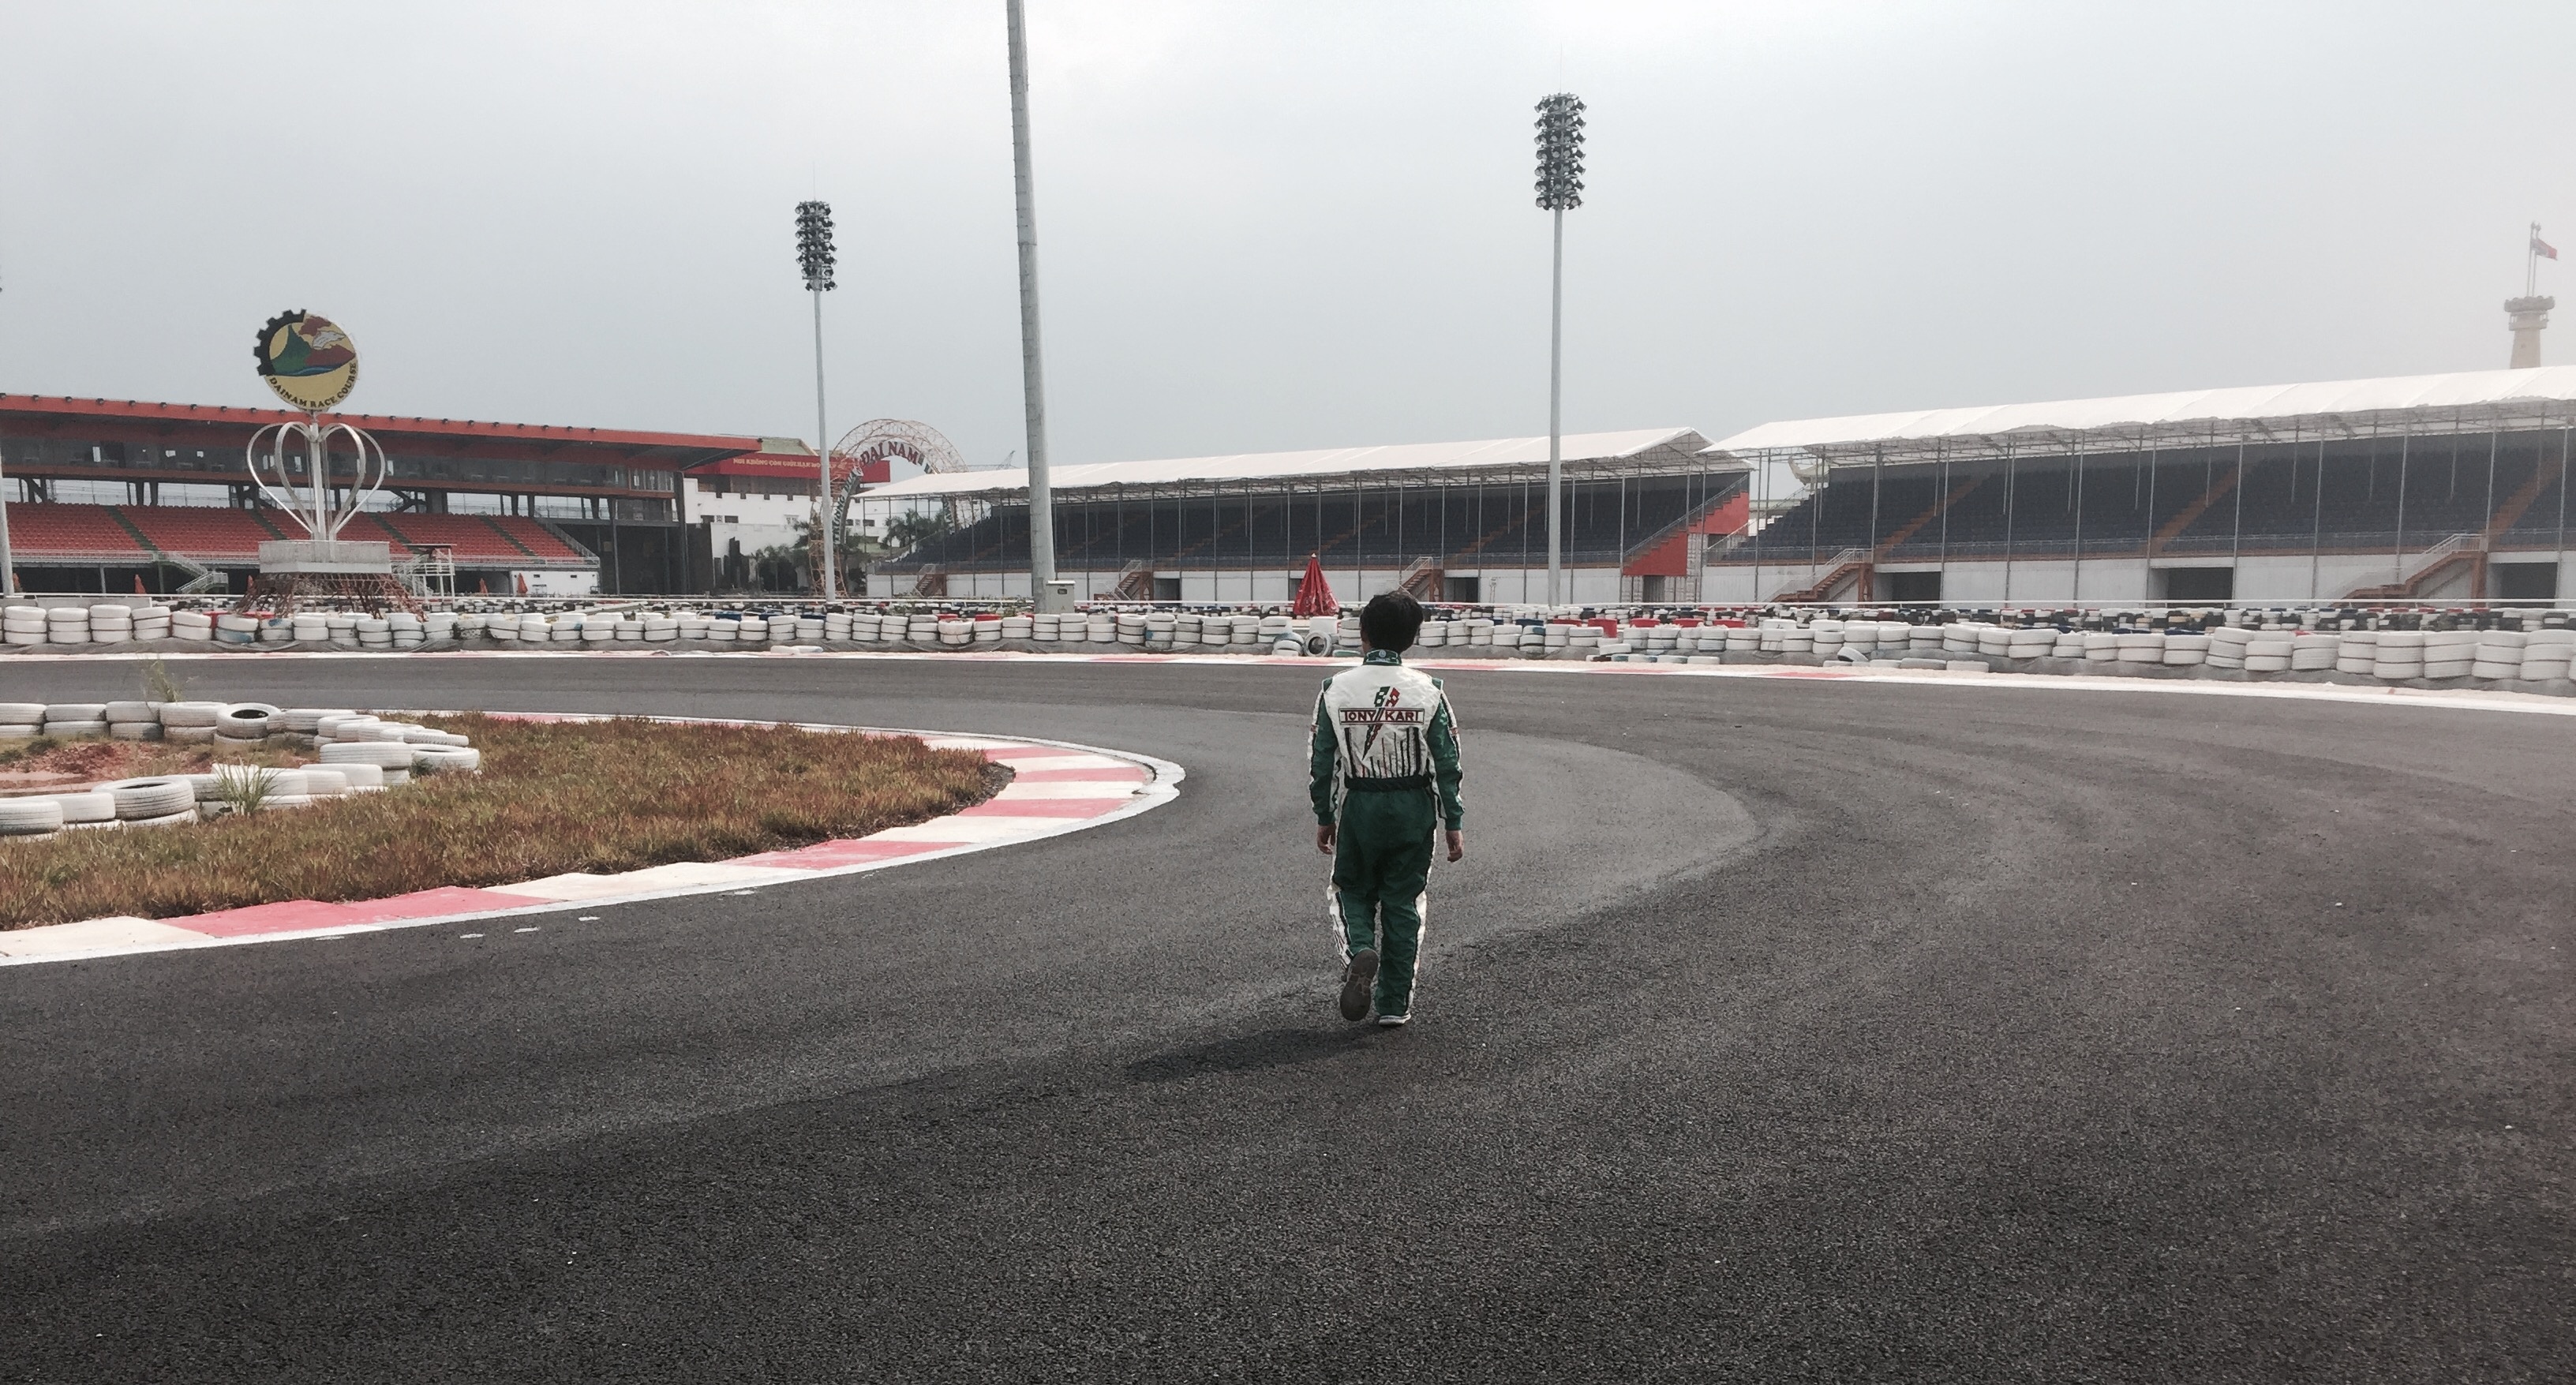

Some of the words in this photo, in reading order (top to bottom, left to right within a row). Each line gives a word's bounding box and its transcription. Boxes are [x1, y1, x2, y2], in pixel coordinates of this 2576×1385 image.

[269, 377, 308, 407] DAINAM
[310, 396, 335, 408] RACE
[336, 362, 357, 399] COURSE
[887, 441, 919, 466] NAM
[1342, 710, 1376, 722] TONY
[1385, 710, 1420, 722] KART
